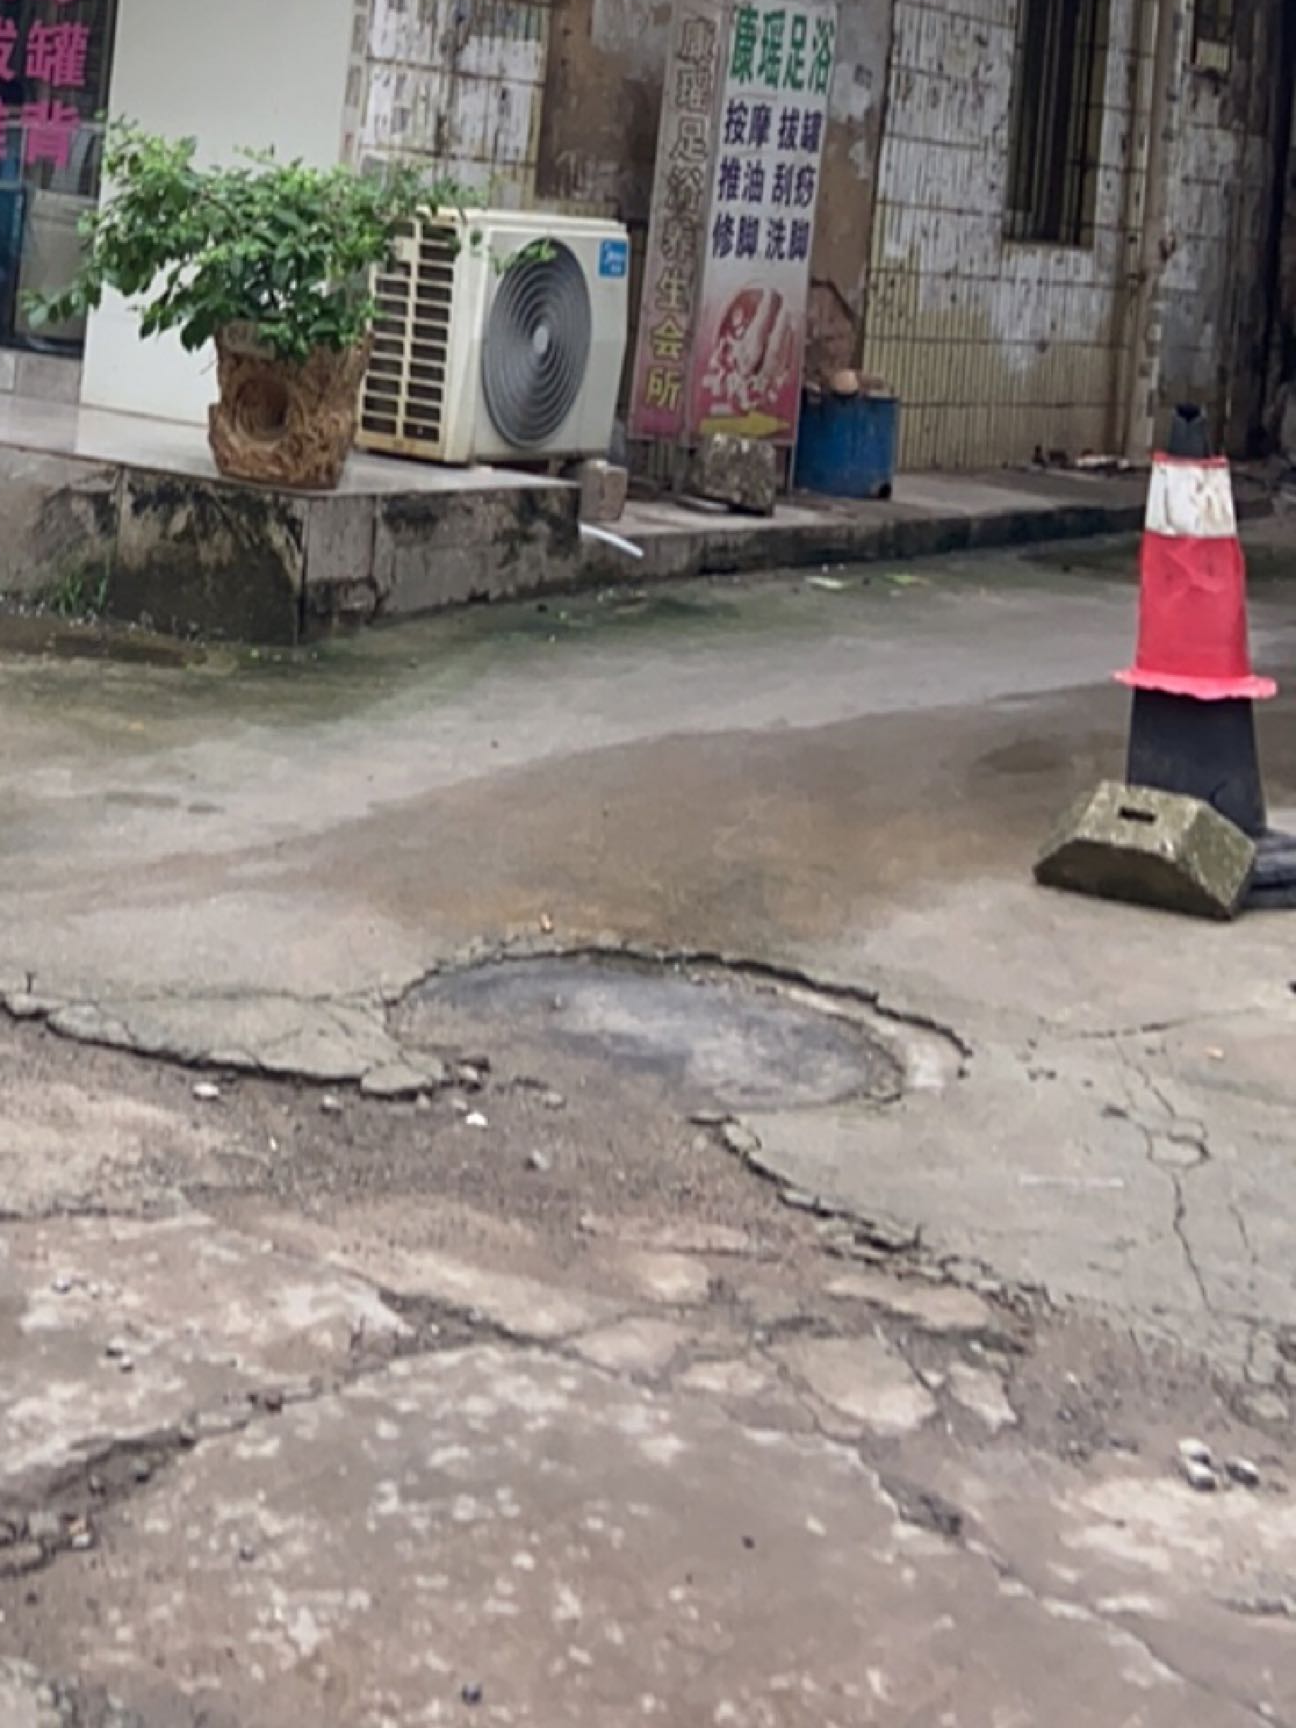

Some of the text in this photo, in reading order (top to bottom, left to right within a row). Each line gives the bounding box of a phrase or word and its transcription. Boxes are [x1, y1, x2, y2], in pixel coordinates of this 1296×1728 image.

[730, 2, 835, 96] 康瑶足浴
[723, 100, 824, 154] 按摩 拔罐
[717, 156, 817, 209] 推油 刮痧
[711, 213, 811, 261] 修脚 洗脚
